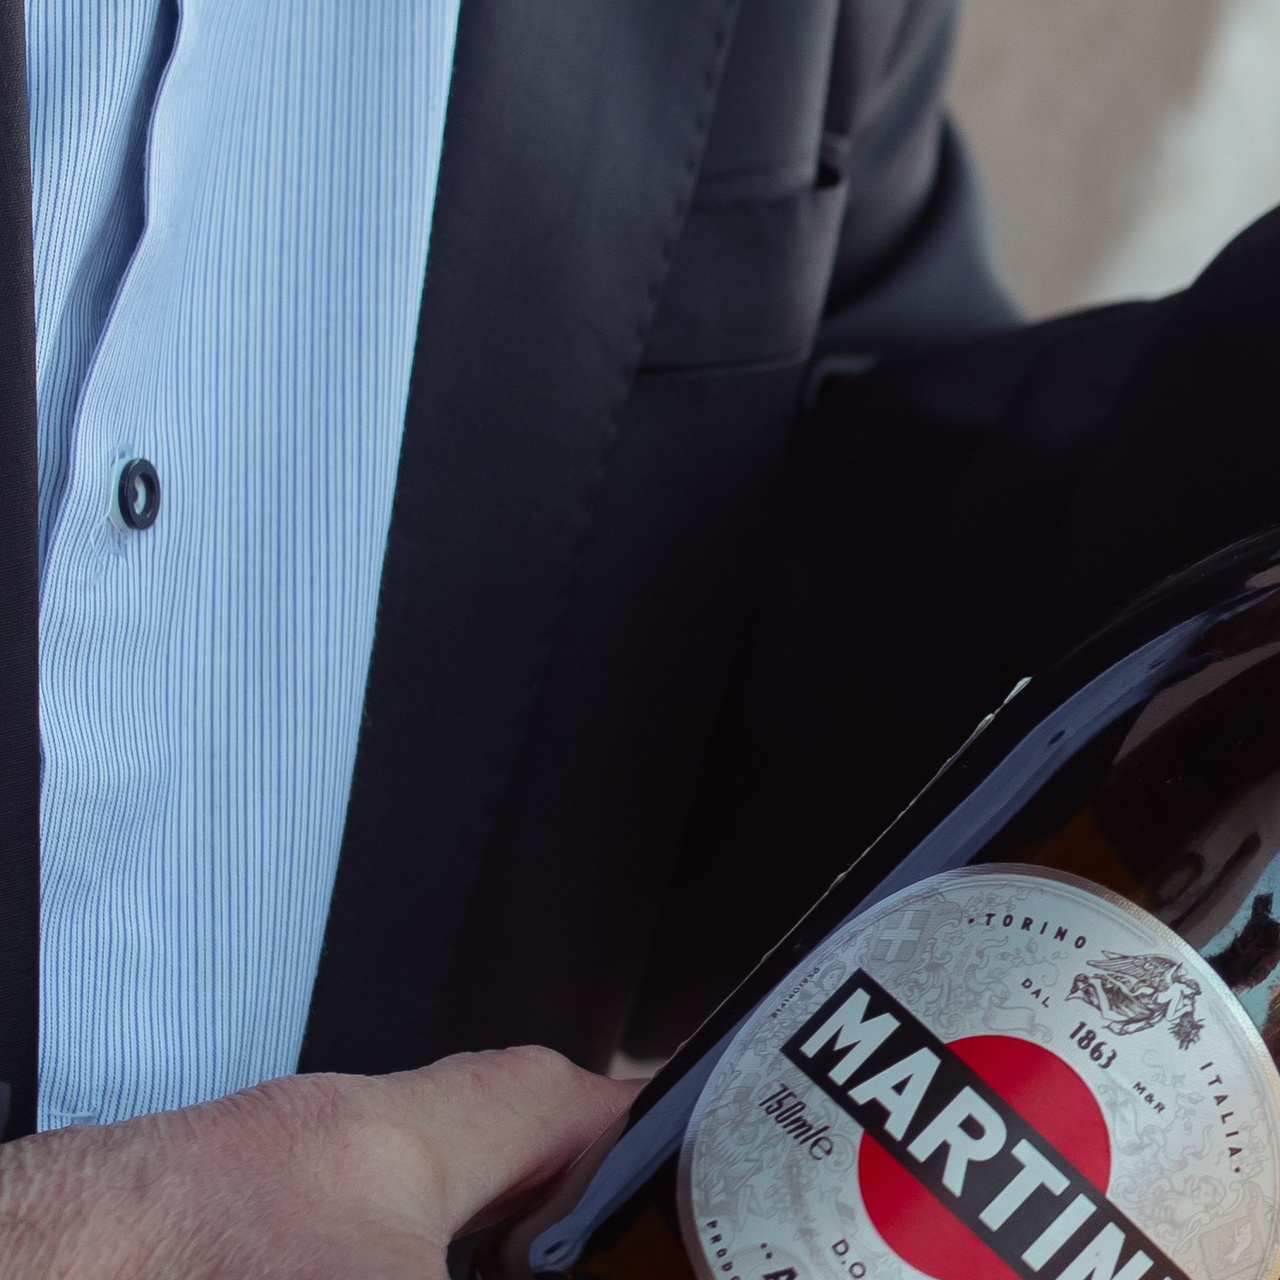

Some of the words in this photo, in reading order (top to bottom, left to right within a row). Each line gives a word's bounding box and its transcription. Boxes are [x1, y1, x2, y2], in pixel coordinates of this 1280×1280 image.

[1021, 977, 1050, 1008] DAL
[984, 912, 1087, 950] TORINO
[1200, 1061, 1243, 1159] ITALIA
[1068, 1021, 1118, 1069] 1863
[1132, 1081, 1166, 1114] M&R
